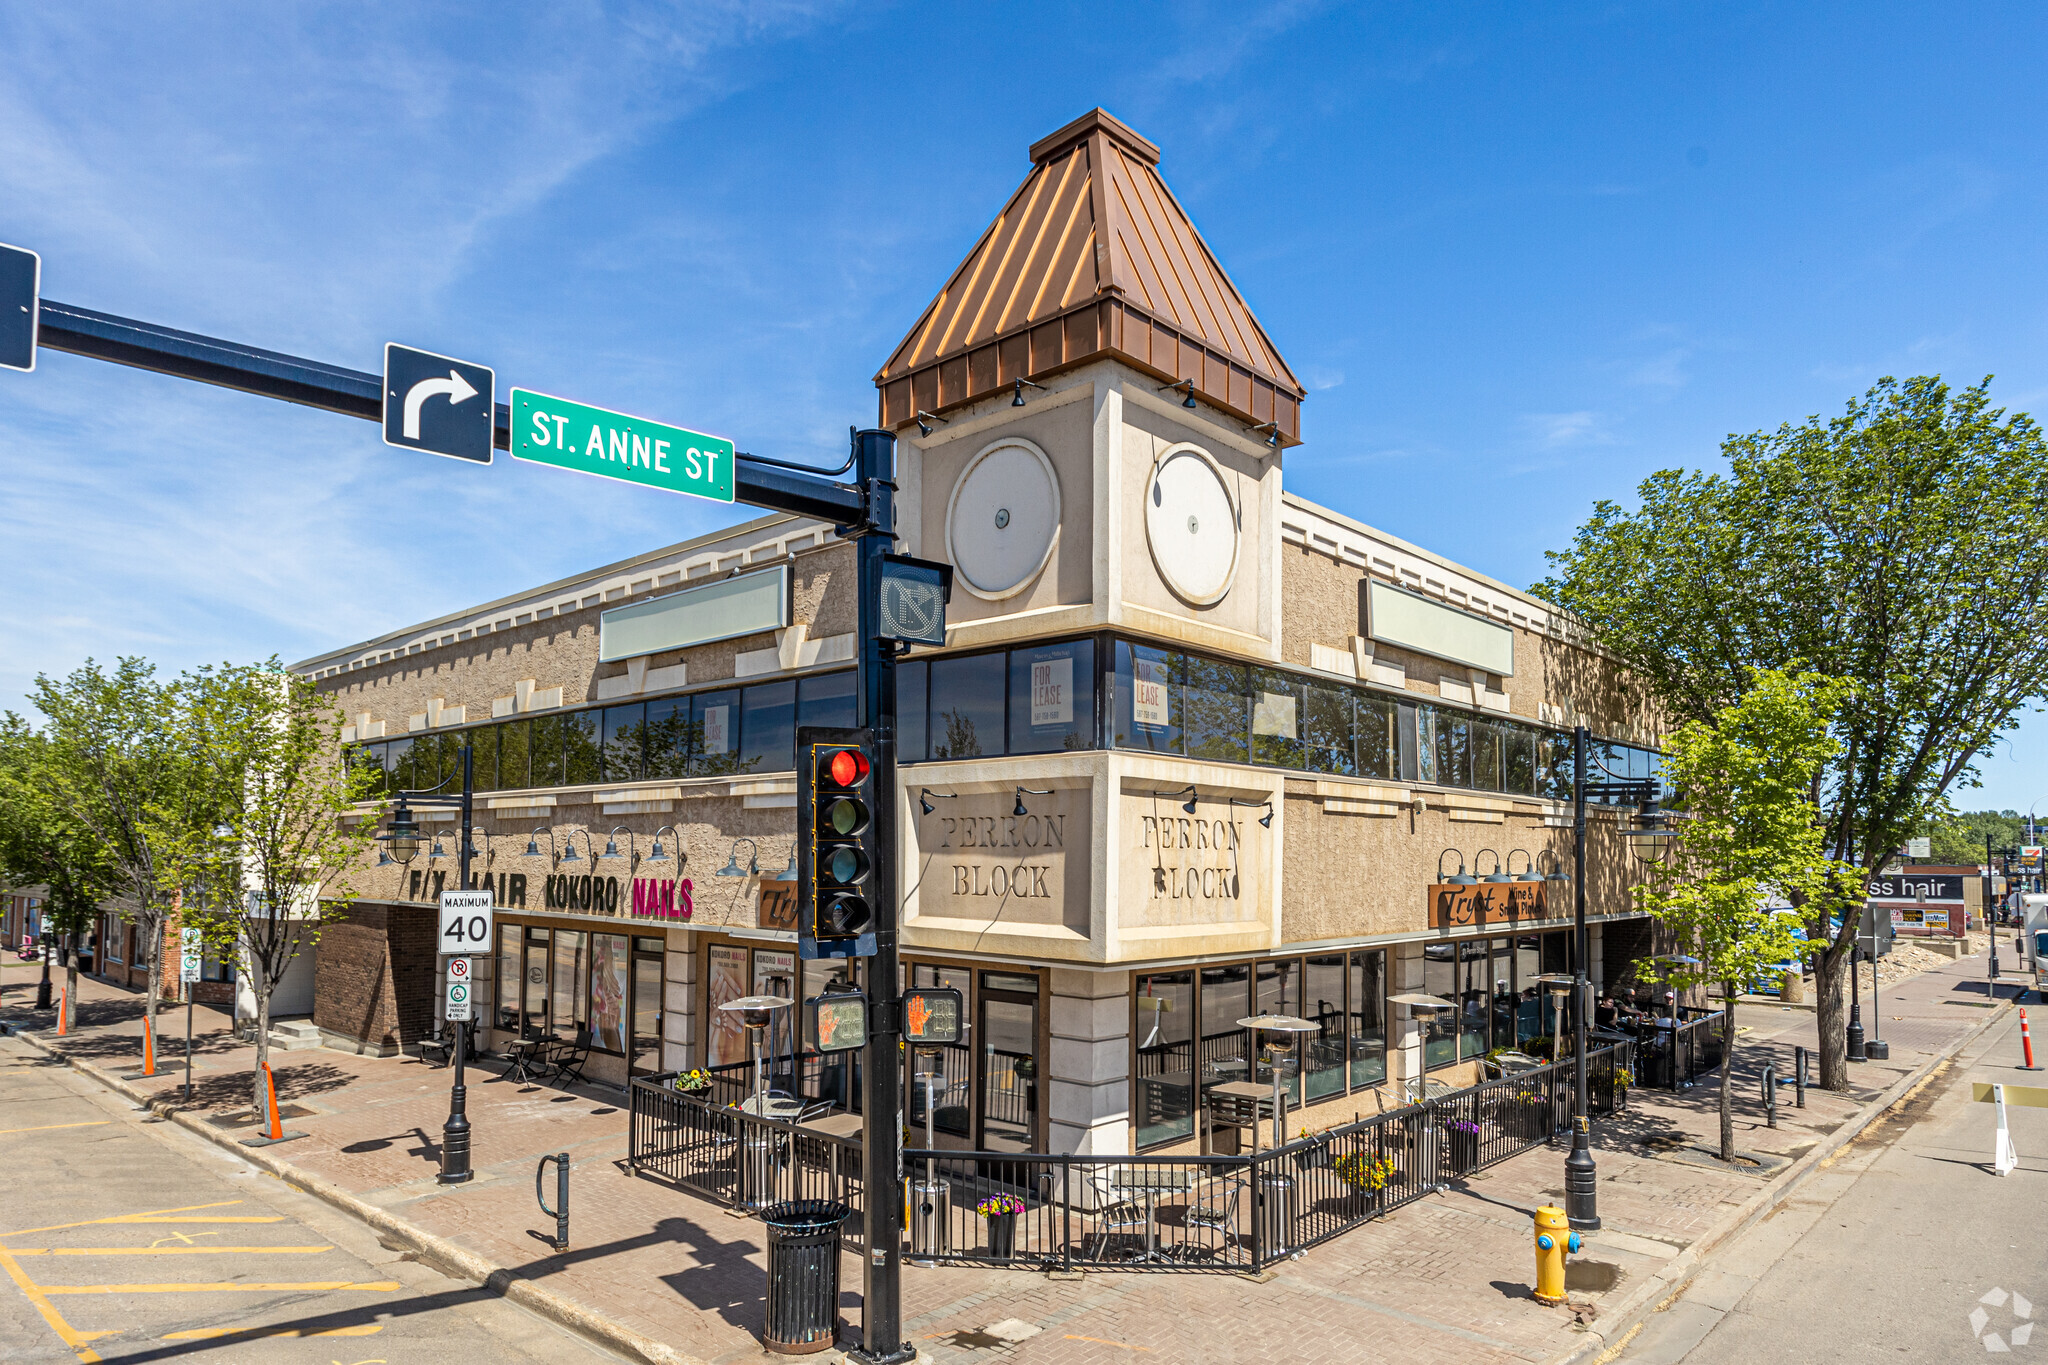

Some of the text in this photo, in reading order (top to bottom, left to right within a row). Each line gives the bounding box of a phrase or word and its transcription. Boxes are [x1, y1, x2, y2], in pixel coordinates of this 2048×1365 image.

[531, 411, 718, 483] ST. ANNE ST
[1034, 665, 1051, 687] FOR
[1136, 662, 1150, 684] FOR
[1034, 684, 1062, 707] LEASE
[1136, 683, 1159, 706] LEASE
[941, 814, 1066, 848] PERRON
[1141, 815, 1243, 850] PERRON
[952, 865, 1051, 898] BLOCK
[1151, 866, 1233, 900] BLOCK
[1508, 886, 1533, 900] Wine &
[1902, 879, 1946, 896] hair
[444, 898, 489, 908] MAXIMUM
[545, 874, 694, 919] KOKORO NAILS
[1437, 885, 1496, 924] Tryst
[1499, 901, 1543, 917] Small Plates
[444, 916, 487, 942] 40
[712, 950, 746, 962] KOKORO NAILS
[756, 954, 792, 966] KOKORO NAILS
